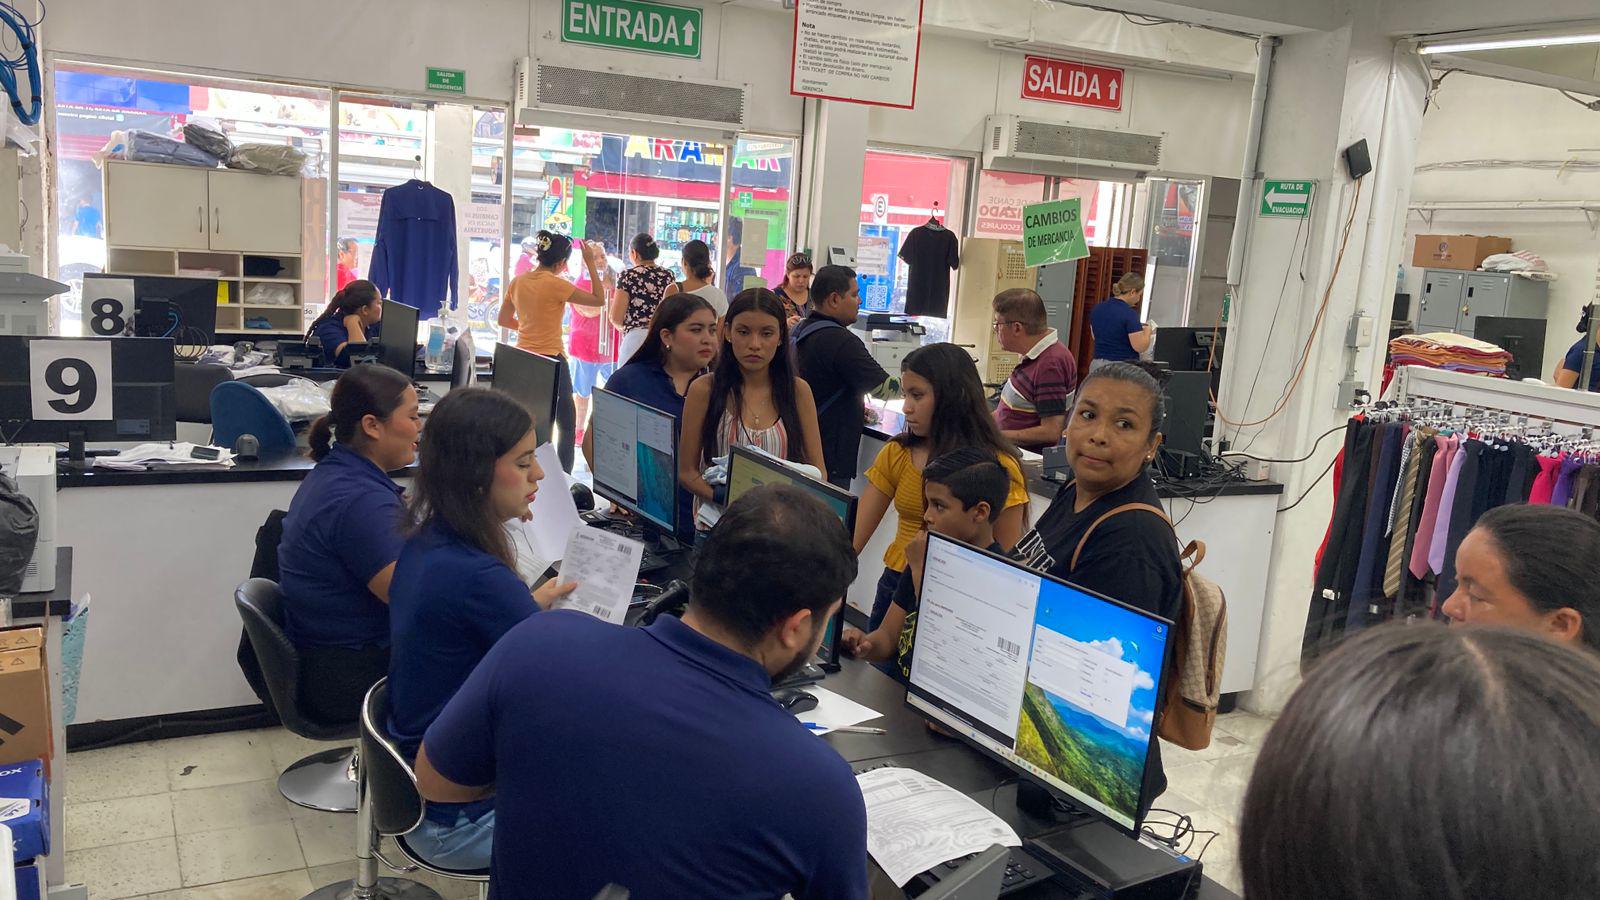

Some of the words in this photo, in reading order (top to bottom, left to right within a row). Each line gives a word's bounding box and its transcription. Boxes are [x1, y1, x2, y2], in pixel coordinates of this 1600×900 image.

[569, 2, 680, 46] ENTRADA
[802, 21, 816, 29] Nota
[429, 82, 463, 91] EMERGENCIA
[1027, 64, 1102, 100] SALIDA
[1025, 208, 1077, 229] CAMBIOS
[1027, 236, 1037, 249] DE
[90, 297, 125, 336] 8
[44, 357, 97, 414] 9
